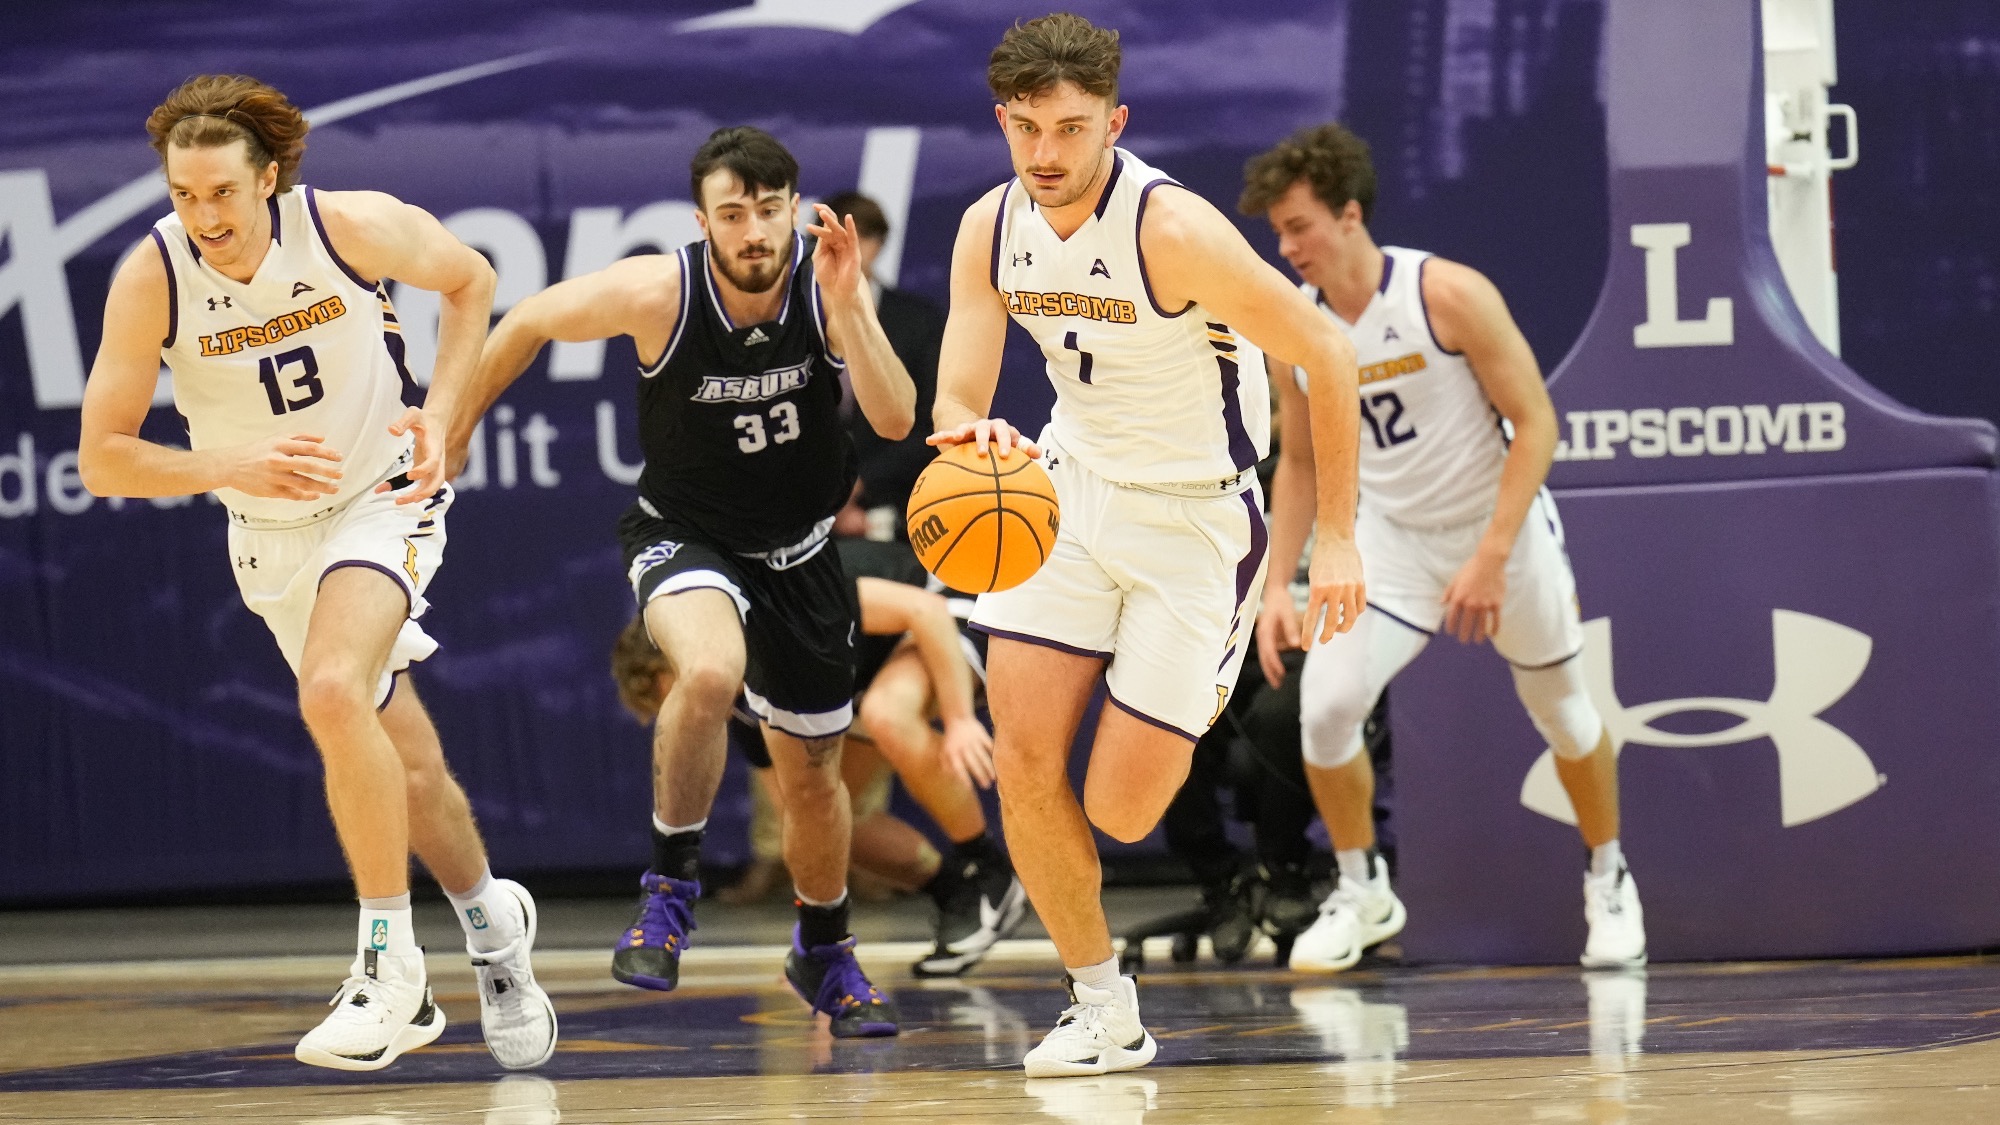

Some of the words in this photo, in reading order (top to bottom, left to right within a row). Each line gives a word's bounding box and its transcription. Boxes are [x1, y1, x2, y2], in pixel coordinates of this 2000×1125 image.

[1002, 290, 1137, 324] LIPSCOMB
[1630, 222, 1734, 349] L
[199, 295, 346, 357] LIPSCOMB
[258, 345, 325, 415] 13
[1063, 331, 1093, 385] 1
[733, 401, 800, 454] 33
[1360, 391, 1418, 449] 12
